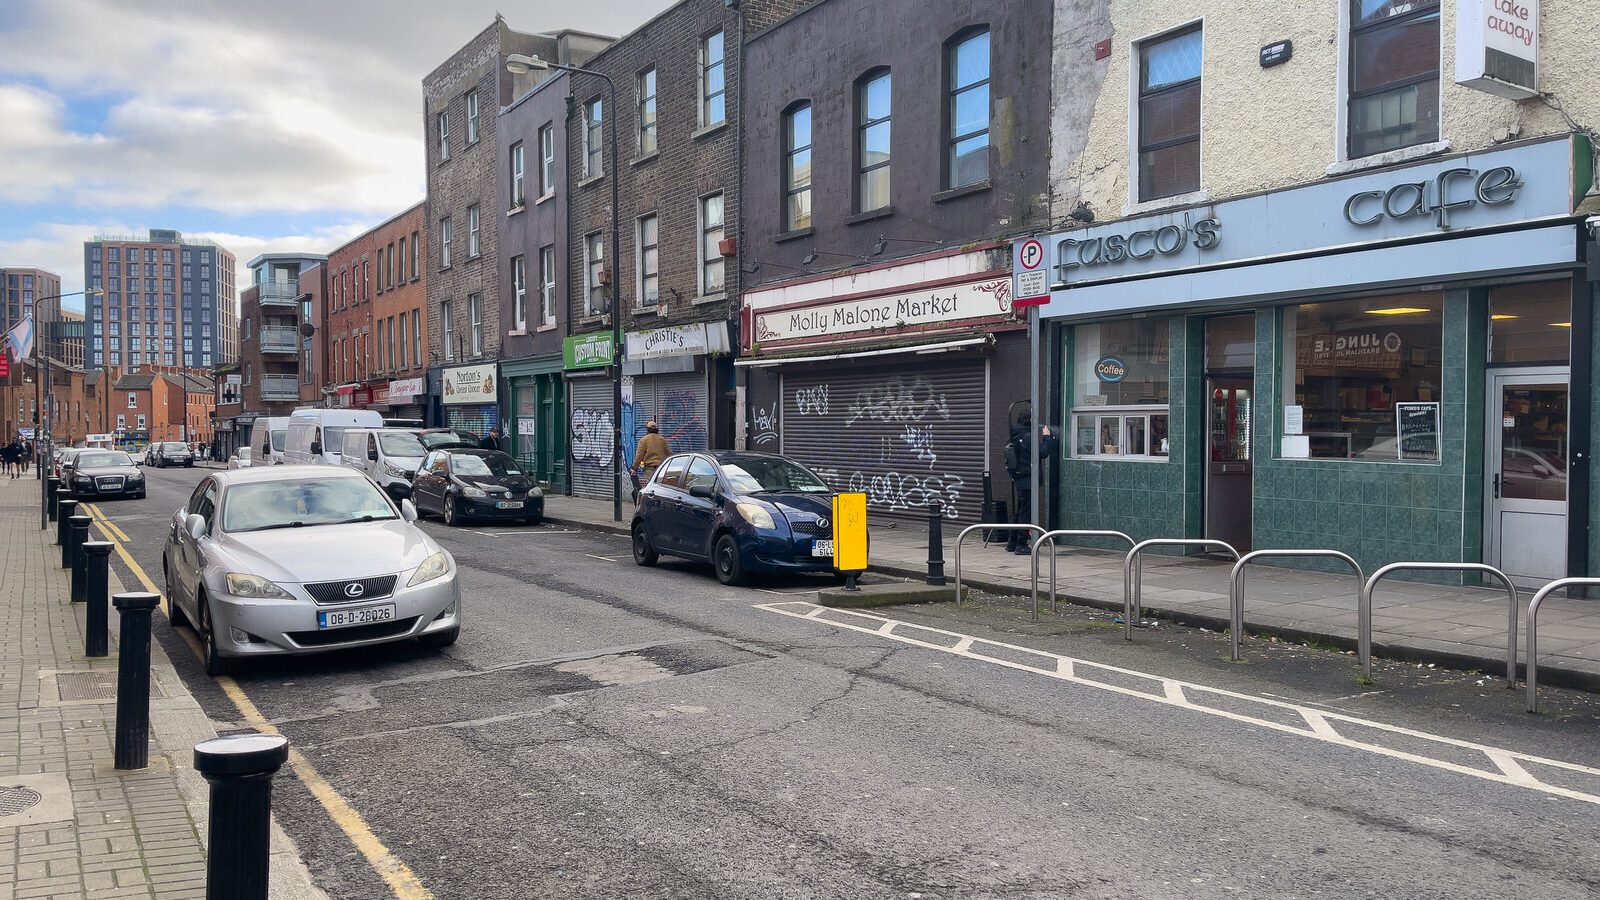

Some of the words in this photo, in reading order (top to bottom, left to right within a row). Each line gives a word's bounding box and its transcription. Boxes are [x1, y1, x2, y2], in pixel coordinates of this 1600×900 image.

[1494, 0, 1529, 20] take
[1487, 15, 1534, 46] away
[789, 310, 828, 333] Molly
[832, 304, 891, 326] Malone
[895, 292, 958, 318] Market
[645, 330, 684, 351] CHRISTIE'S
[576, 341, 595, 364] CUSTOM
[595, 340, 611, 360] PRINT
[456, 370, 481, 382] Norton's
[1097, 363, 1124, 375] Coffee
[331, 608, 390, 625] 08-D-26026
